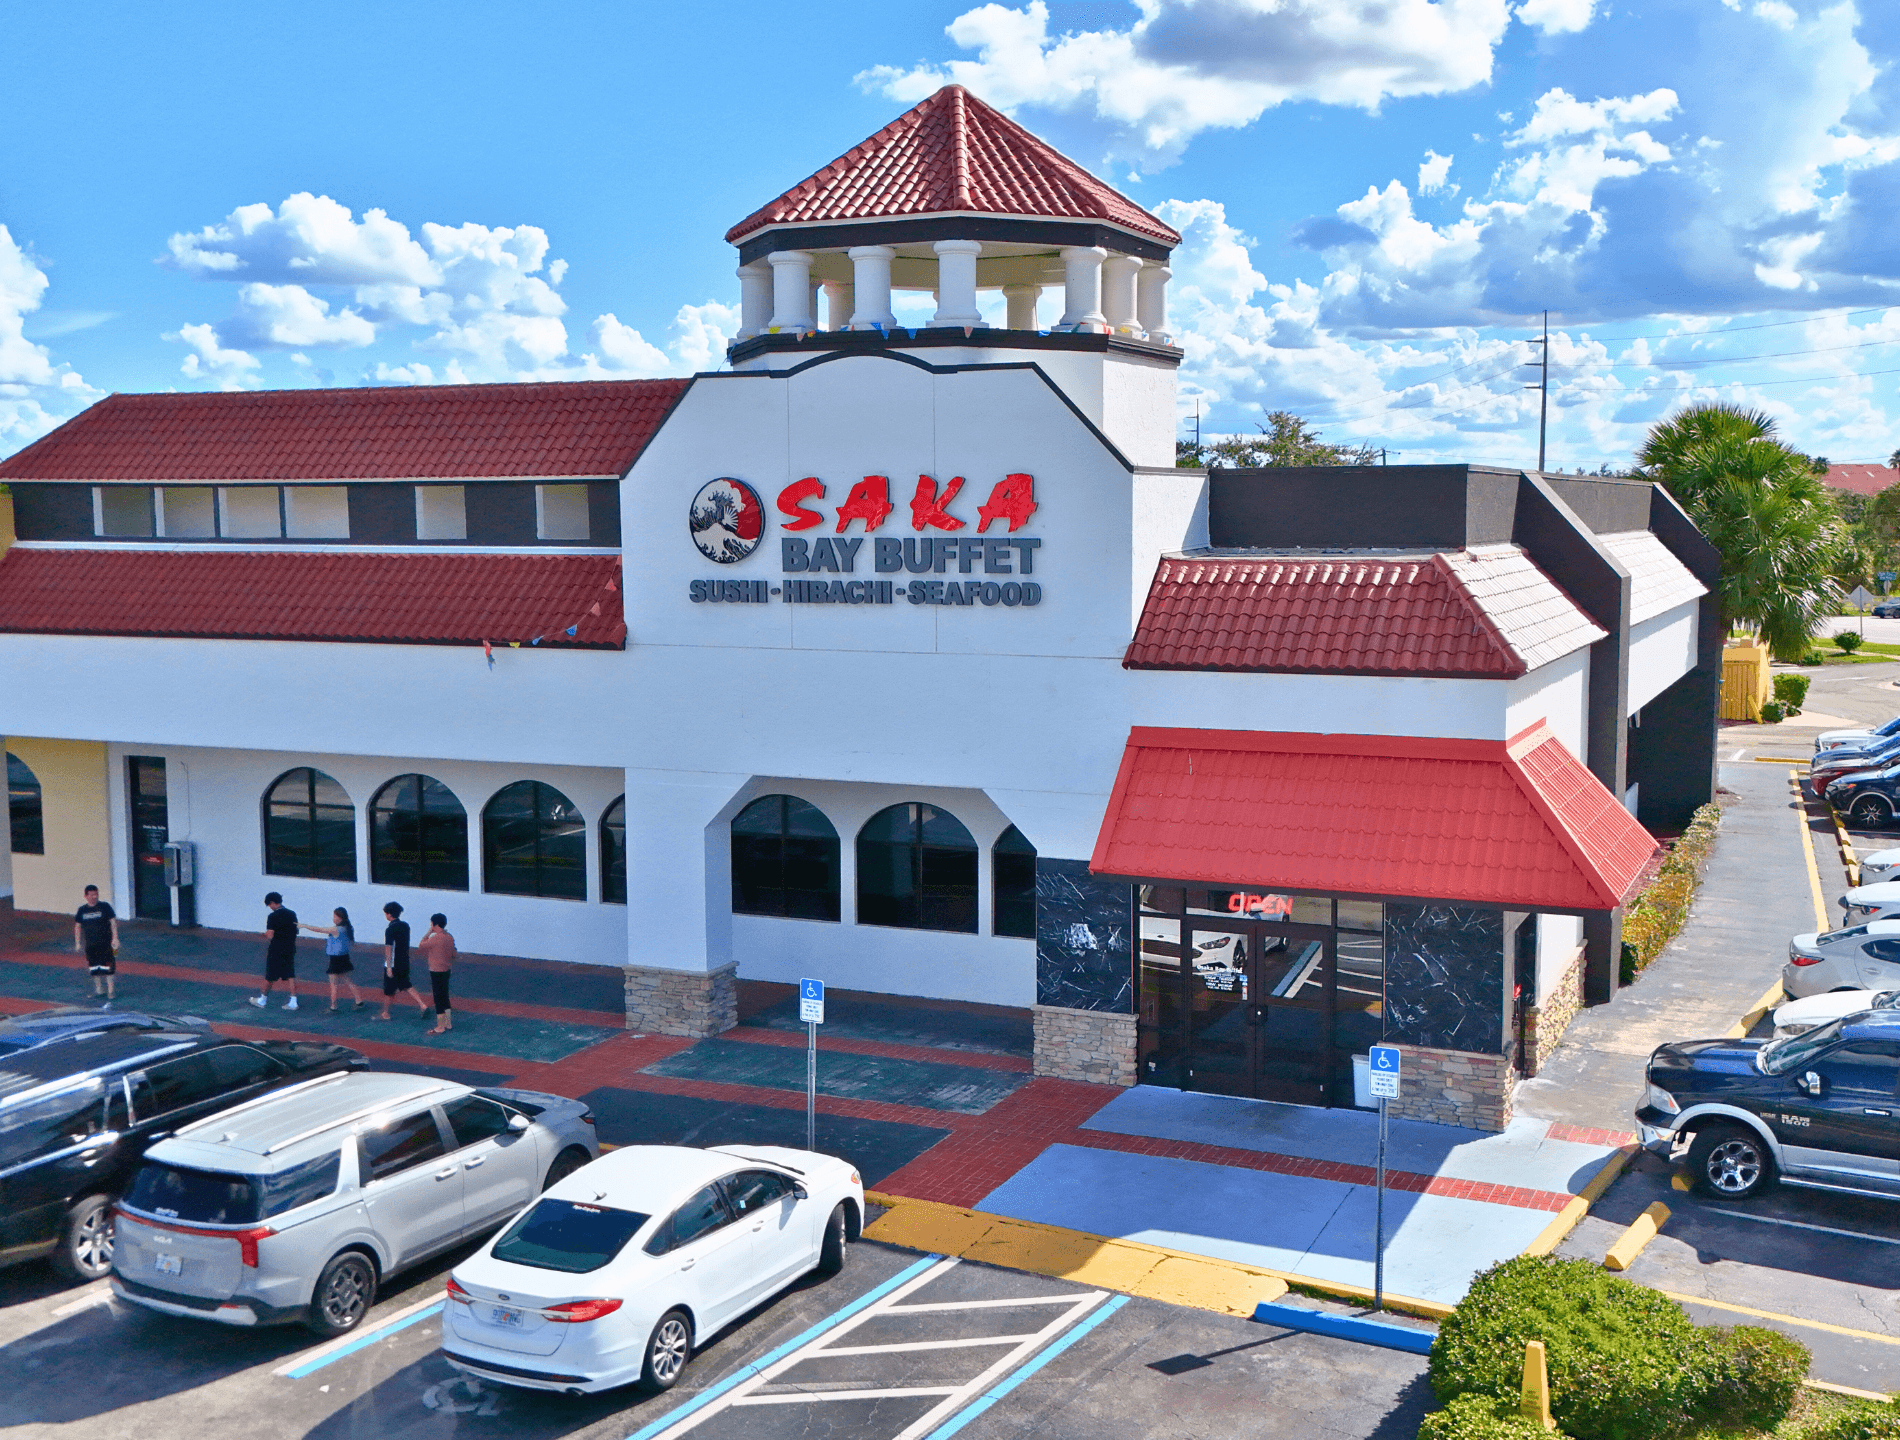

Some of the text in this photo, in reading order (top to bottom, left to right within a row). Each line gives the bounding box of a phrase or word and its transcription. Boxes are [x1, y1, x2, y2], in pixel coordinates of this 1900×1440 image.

[776, 473, 1038, 533] SAKA
[781, 537, 1041, 574] BAY BUFFET
[689, 579, 1042, 606] SUSHI HIBACHI SEAFOOD
[1228, 894, 1294, 915] OPEN
[1781, 1114, 1810, 1122] RAM
